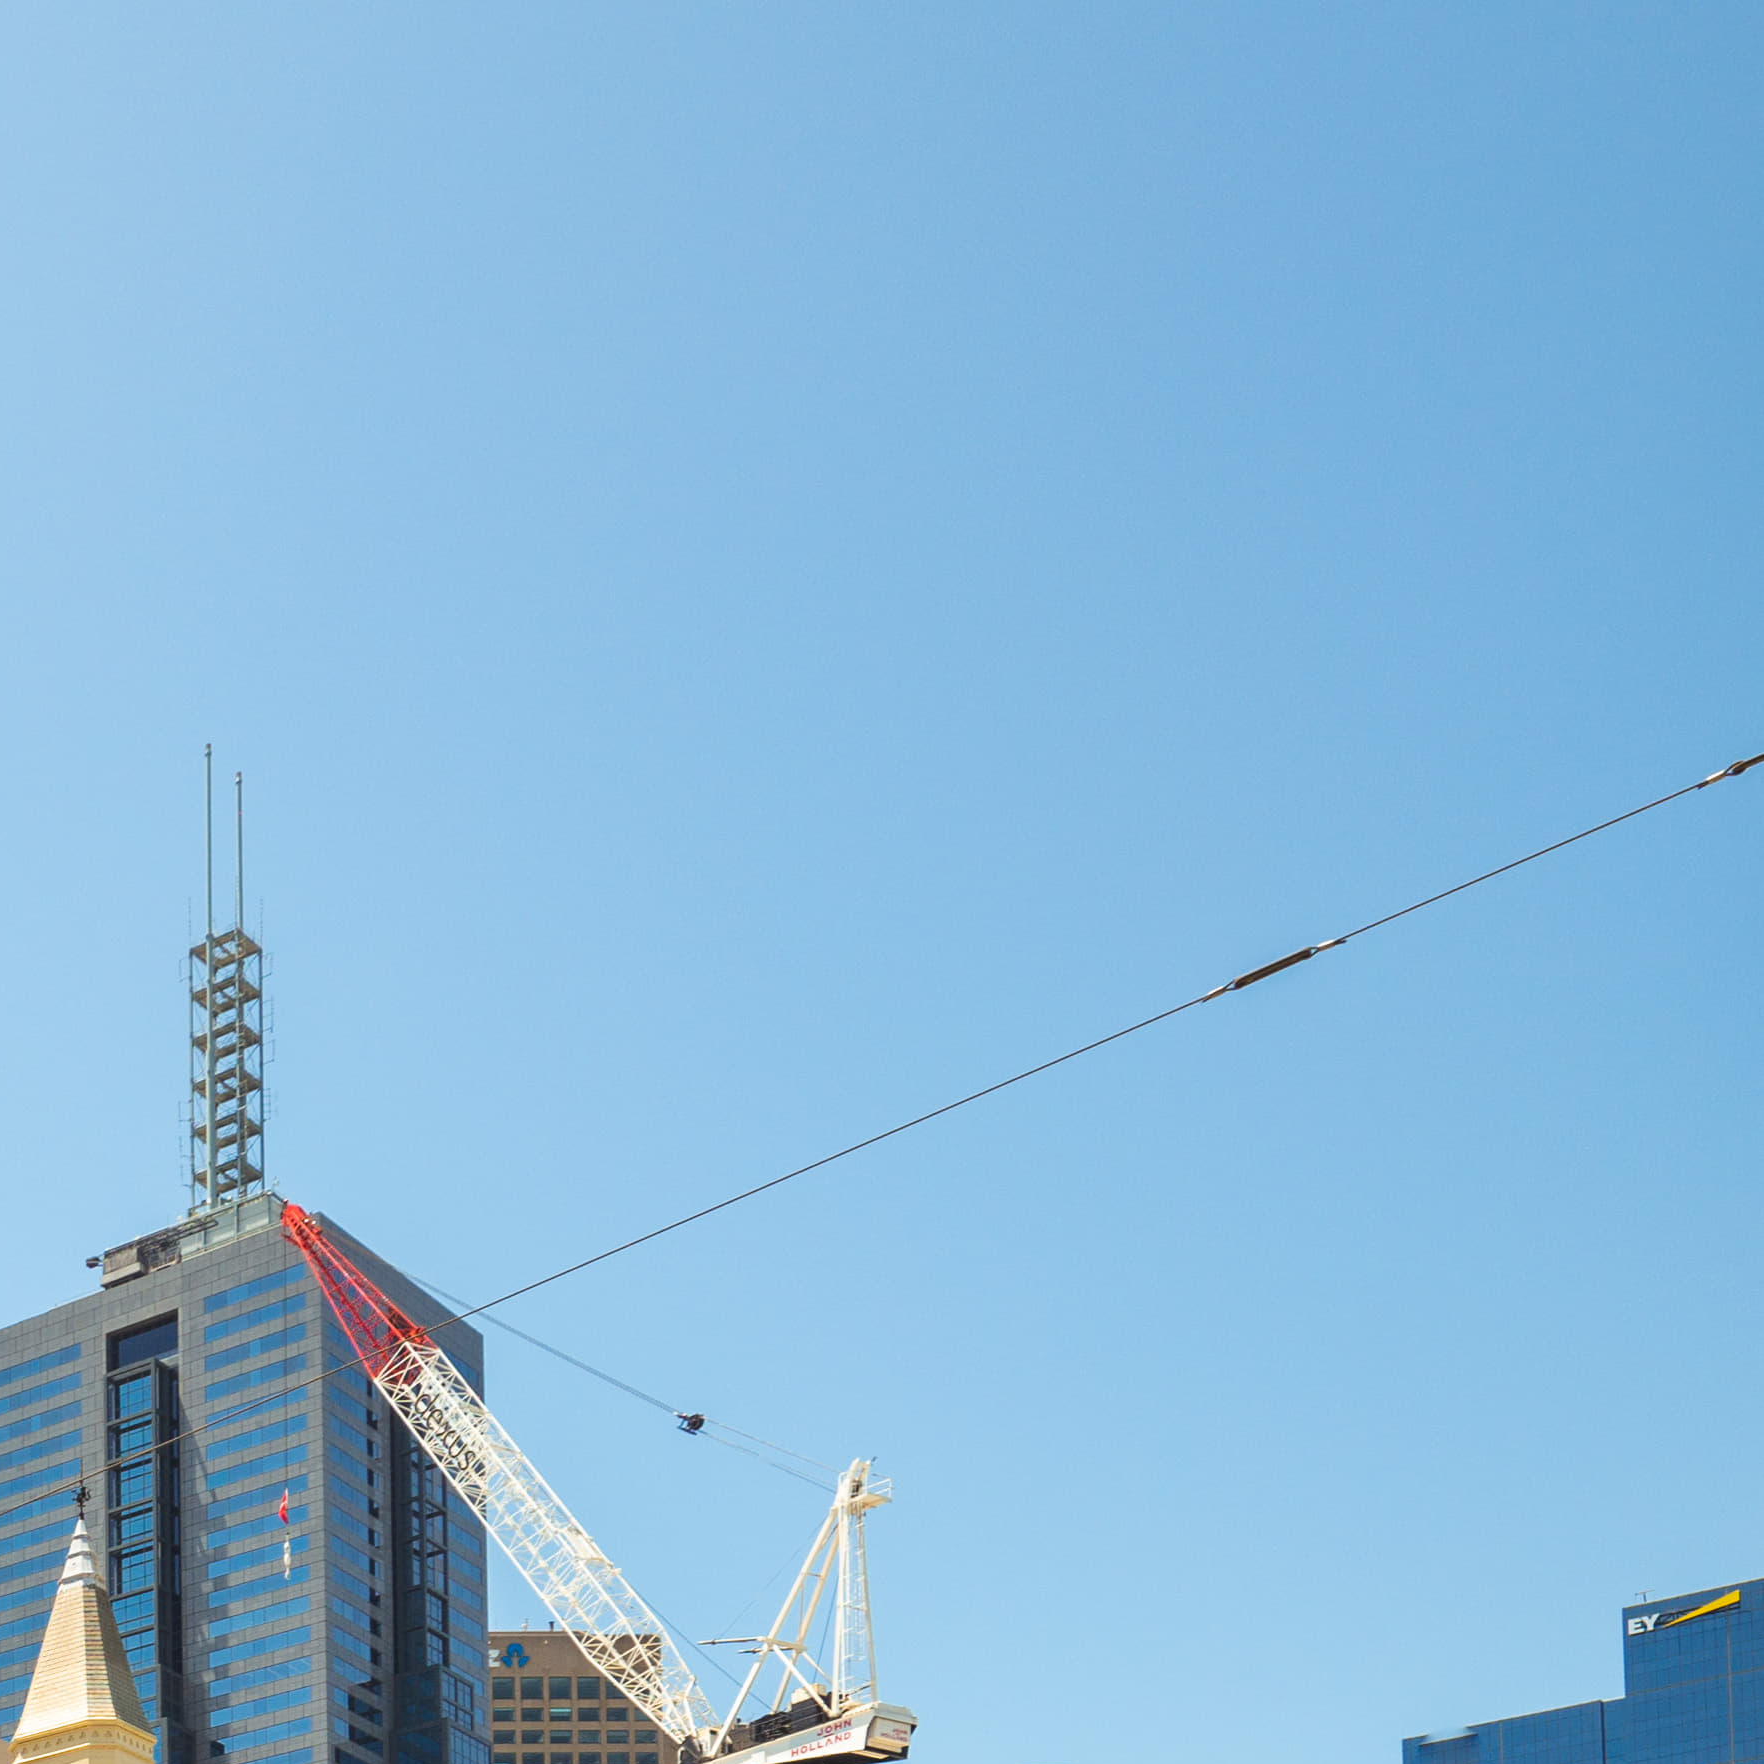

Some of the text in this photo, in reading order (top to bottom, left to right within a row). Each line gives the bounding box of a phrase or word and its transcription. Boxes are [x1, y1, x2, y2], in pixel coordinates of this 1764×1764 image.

[415, 1393, 476, 1471] dexus
[1627, 1612, 1660, 1636] EY
[817, 1718, 852, 1737] JOHN
[791, 1731, 852, 1757] HOLLAND
